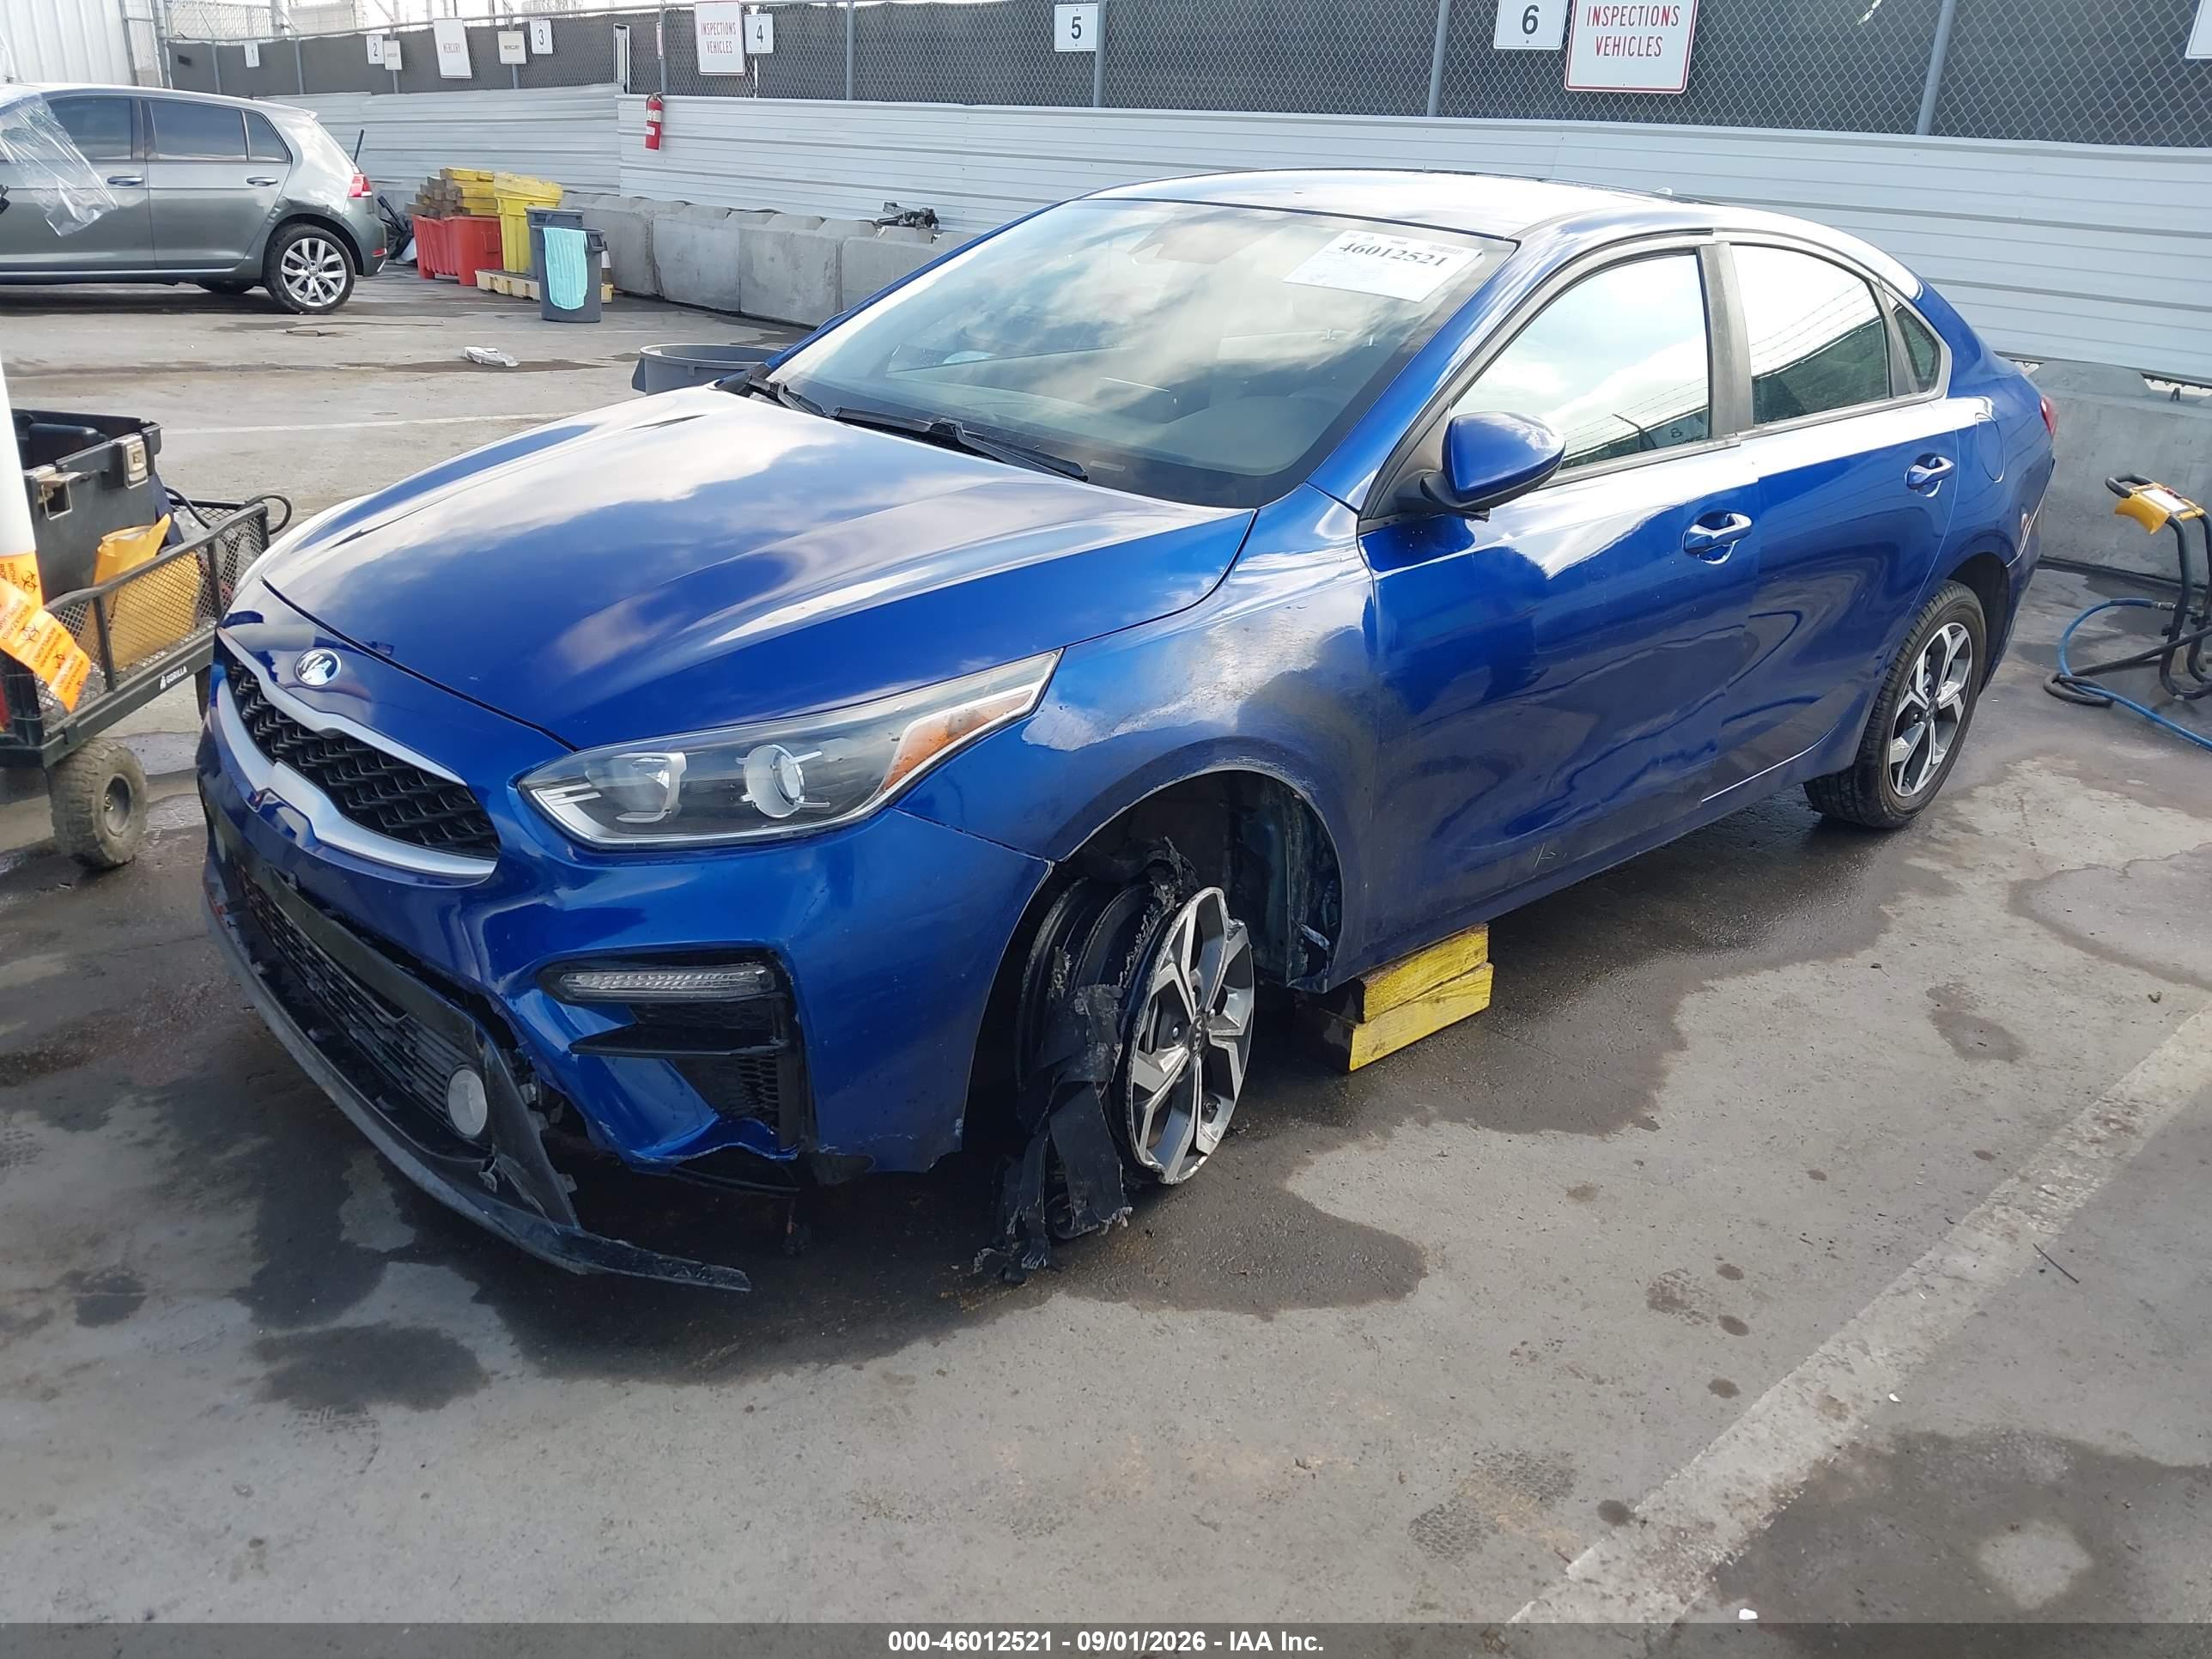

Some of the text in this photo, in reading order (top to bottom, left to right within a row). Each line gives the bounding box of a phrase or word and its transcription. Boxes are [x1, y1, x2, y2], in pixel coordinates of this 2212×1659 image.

[1522, 4, 1540, 35] 6
[1586, 4, 1681, 27] INSPECTIONS
[538, 29, 544, 46] 3
[701, 22, 737, 36] INSPECTIONS
[756, 24, 764, 43] 4
[1071, 15, 1082, 40] 5
[373, 42, 379, 58] 2
[706, 41, 733, 54] VEHICLES
[1595, 35, 1663, 58] VEHICLES
[1339, 242, 1449, 267] 46012521
